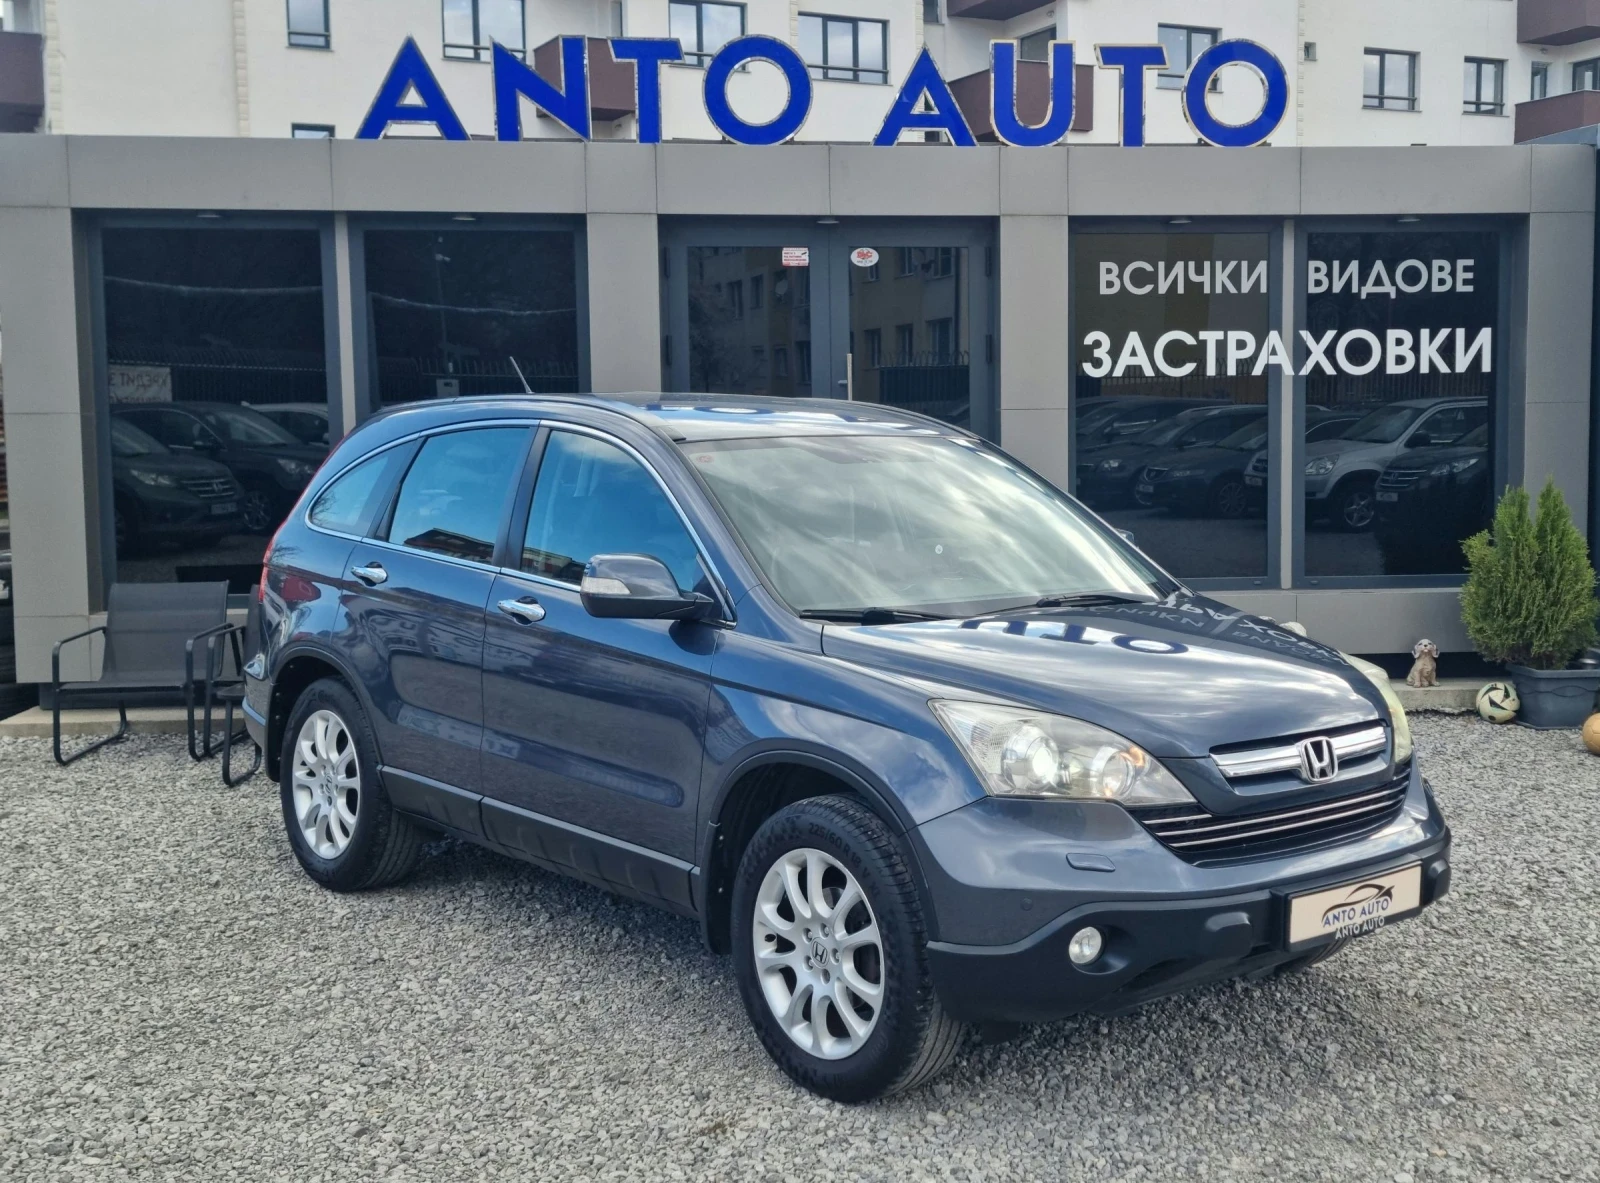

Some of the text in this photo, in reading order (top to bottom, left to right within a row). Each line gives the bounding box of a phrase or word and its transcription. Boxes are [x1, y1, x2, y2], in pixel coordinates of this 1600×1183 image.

[354, 34, 1291, 147] ANTO AUTO
[1099, 259, 1475, 299] ВСИЧКИ ВИДОВЕ
[1082, 327, 1493, 378] ЗАСТРАХОВКИ
